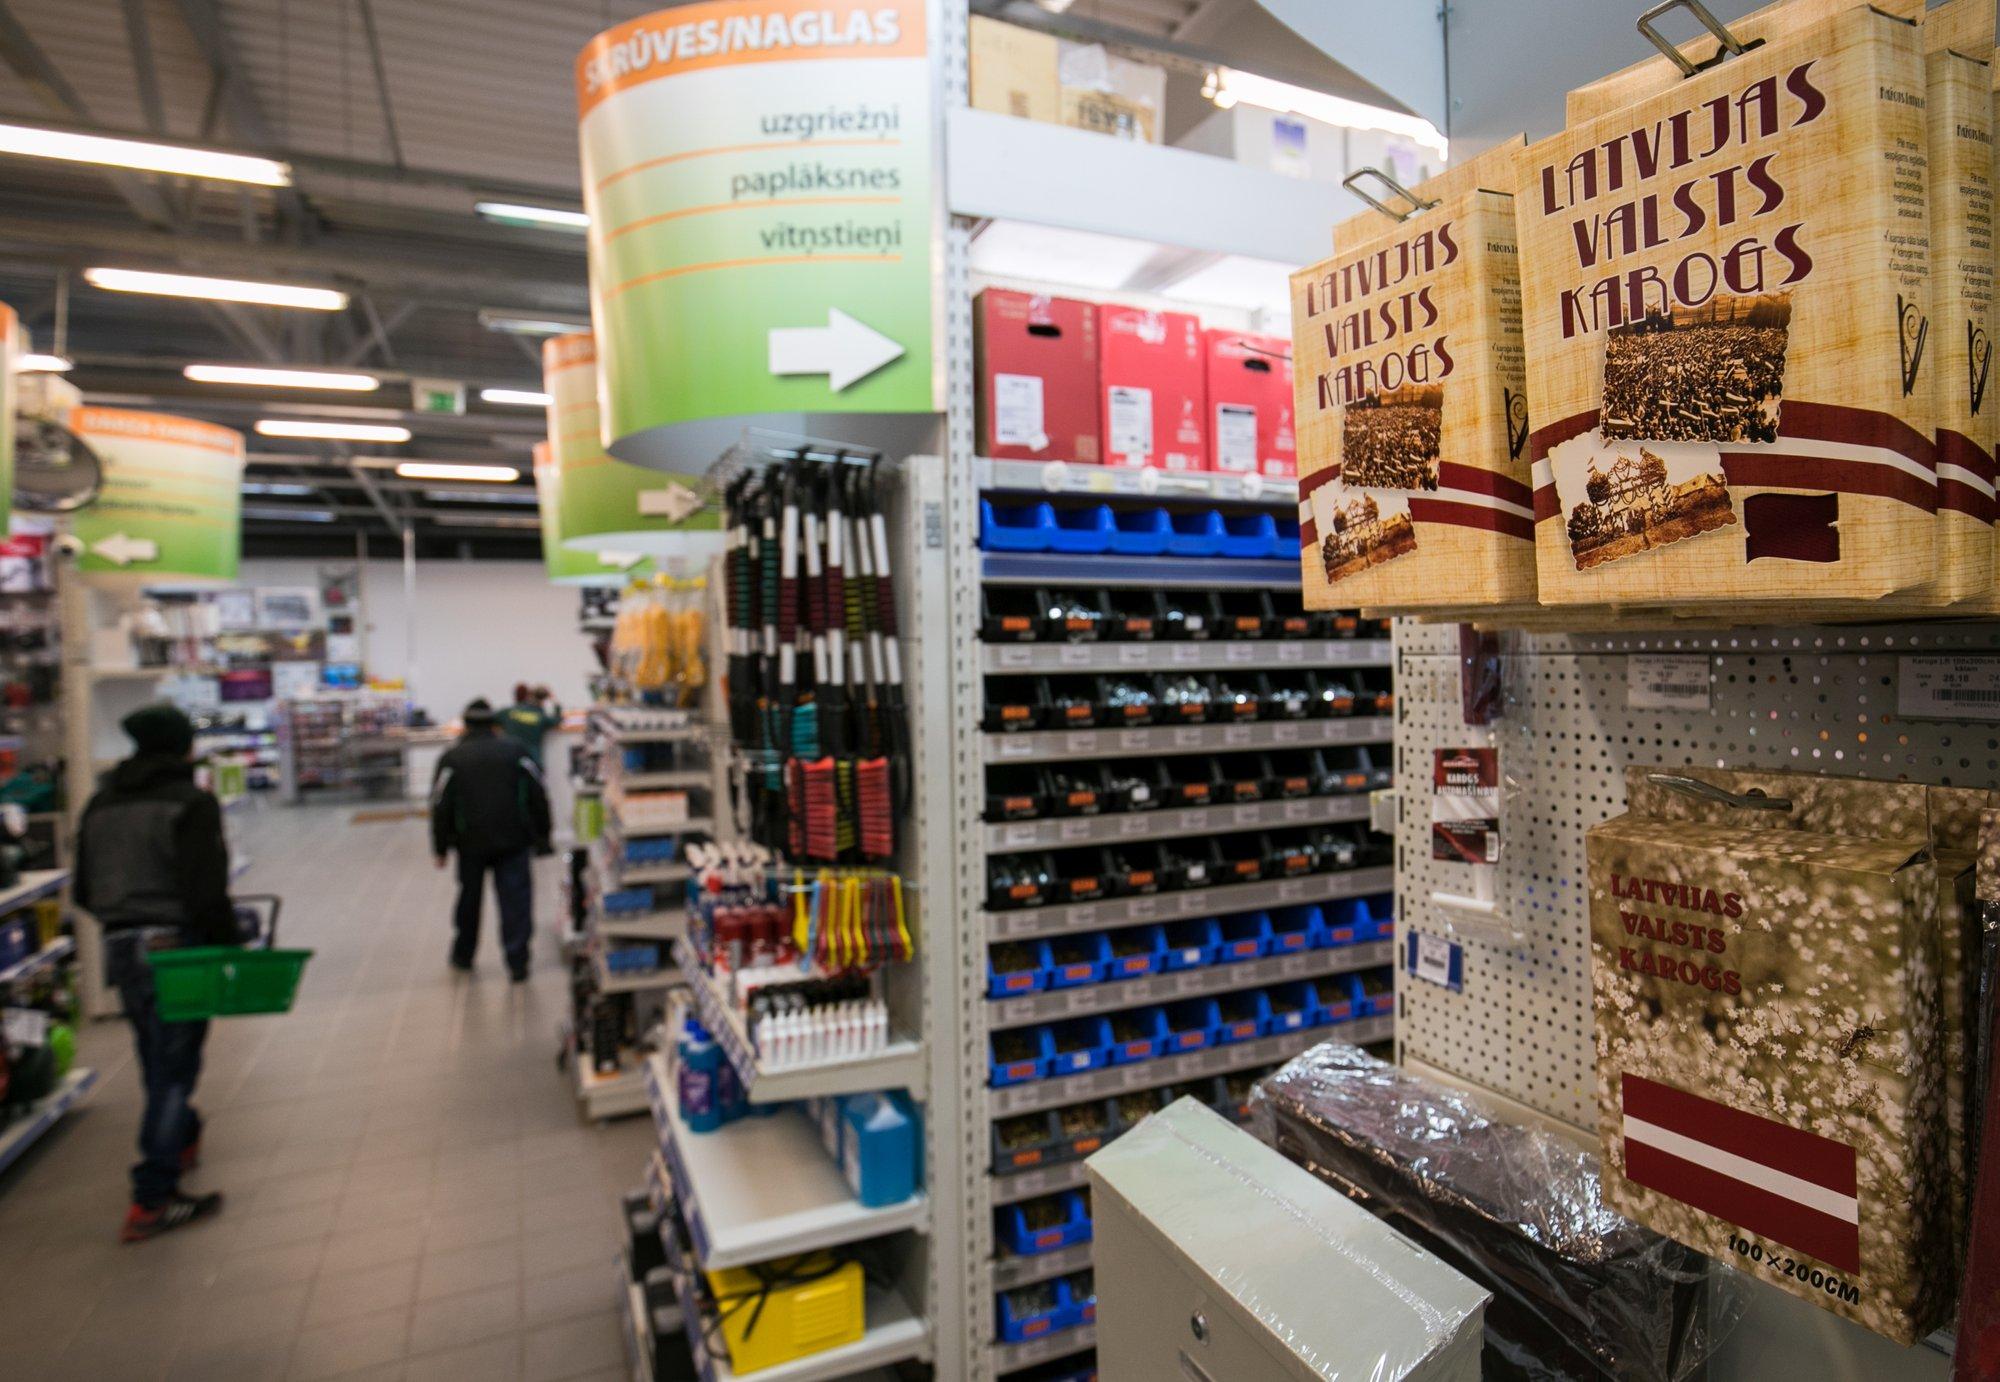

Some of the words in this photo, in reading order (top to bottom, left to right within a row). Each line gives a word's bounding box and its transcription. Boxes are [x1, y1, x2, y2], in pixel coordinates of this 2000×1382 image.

[761, 104, 900, 140] uzgriežņi
[1541, 58, 1826, 217] LATVIJAS
[731, 161, 901, 199] paplāksnes
[1571, 152, 1785, 269] VALSTS
[760, 219, 902, 256] vītņstieņi
[1307, 221, 1460, 318] LATVIJAS
[1560, 222, 1814, 340] KAROGS
[1324, 285, 1440, 359] VALSTS
[1317, 335, 1456, 411] KAROGS
[1620, 910, 1727, 954] VALSTS
[1618, 946, 1743, 996] KAROGS
